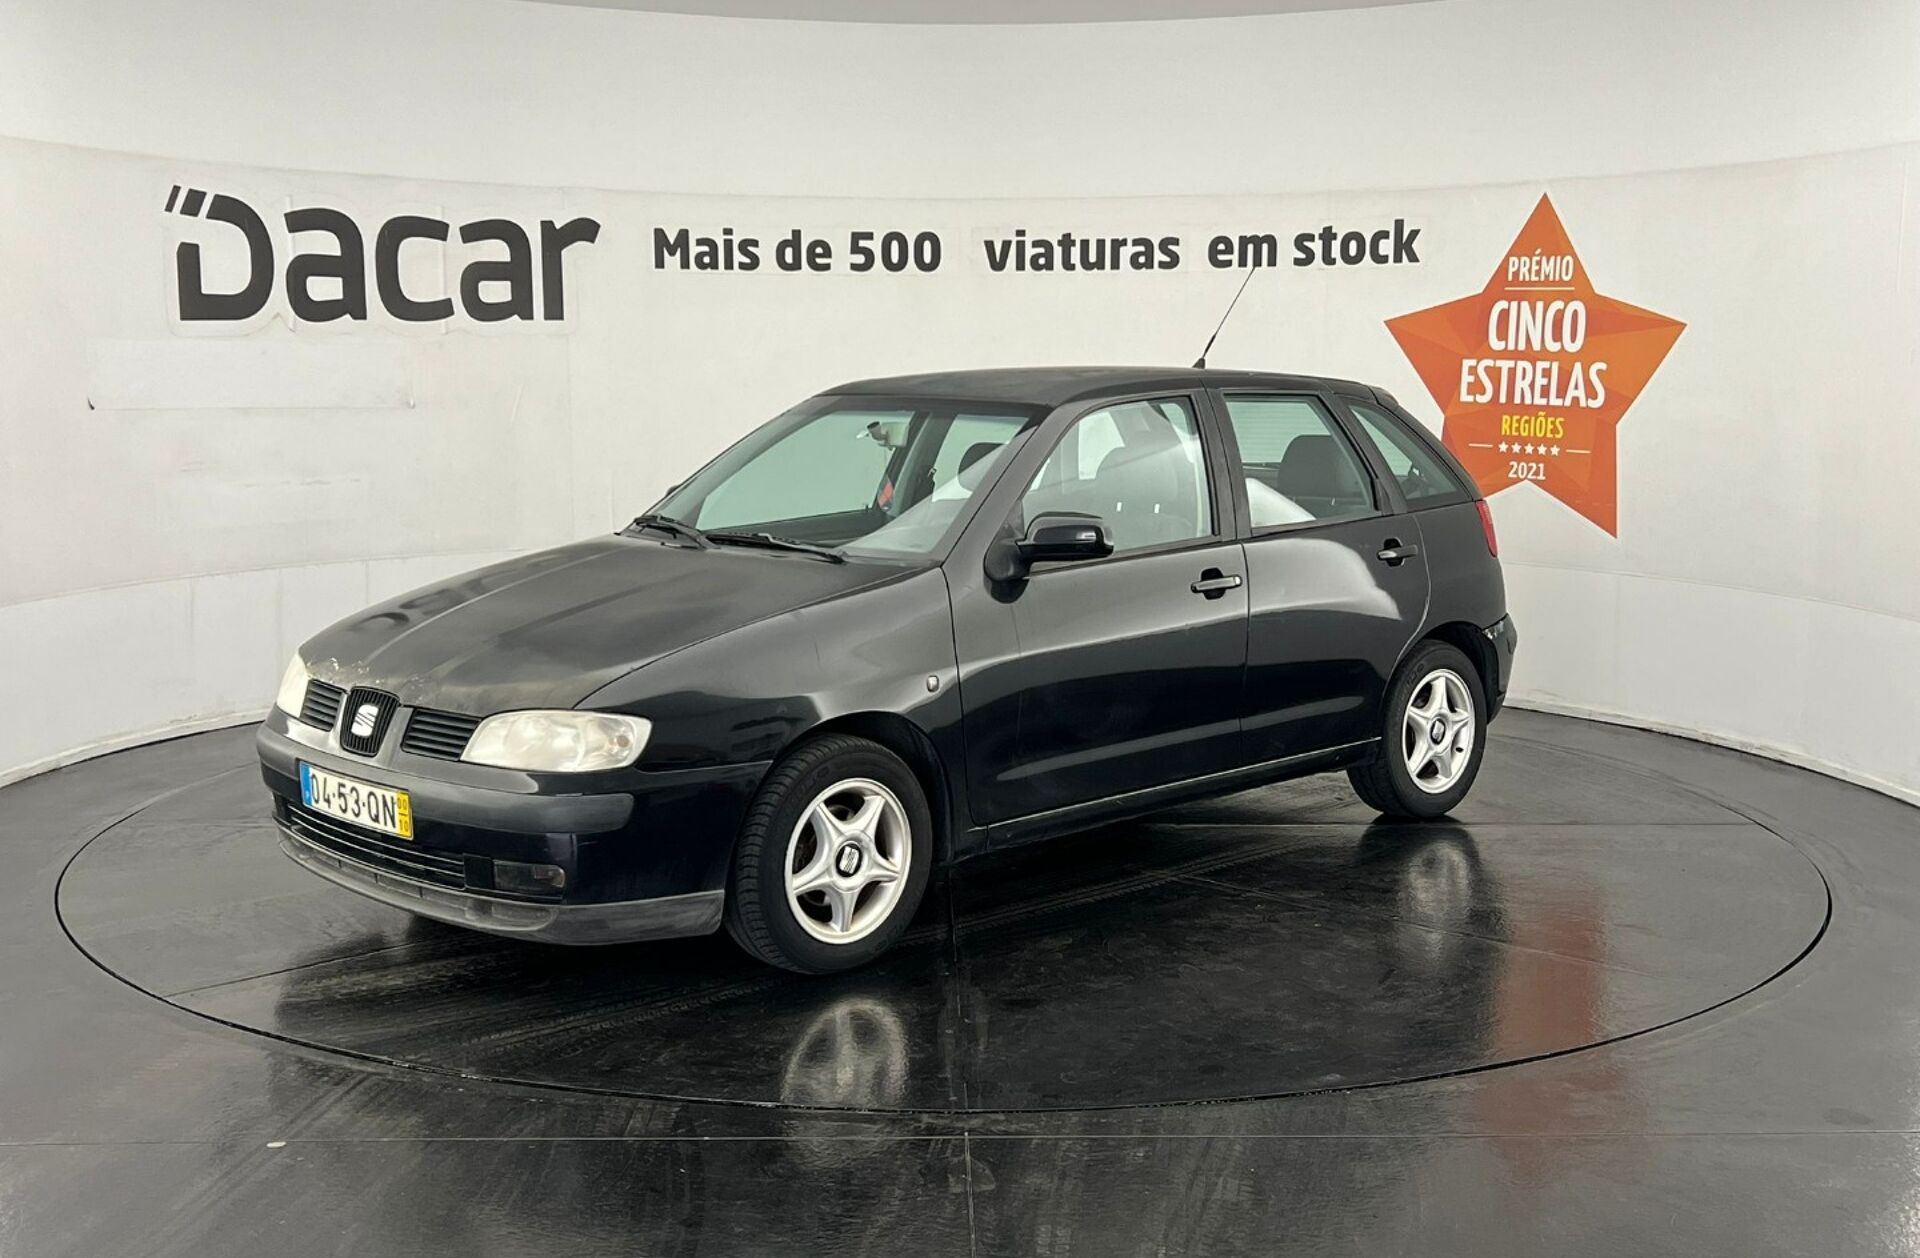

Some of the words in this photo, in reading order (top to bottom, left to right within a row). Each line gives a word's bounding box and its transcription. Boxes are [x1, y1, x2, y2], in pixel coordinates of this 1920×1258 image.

[164, 185, 601, 323] Dacar
[653, 228, 761, 271] Mais
[775, 229, 833, 272] de
[849, 231, 942, 273] 500
[983, 229, 1181, 272] viaturas
[1207, 233, 1278, 269] em
[1292, 218, 1422, 267] stock
[1507, 248, 1574, 282] PRÉMIO
[1488, 300, 1587, 353] CINCO
[1459, 358, 1608, 409] ESTRELAS
[1501, 411, 1565, 439] REGIÕES
[1508, 460, 1546, 481] 2021
